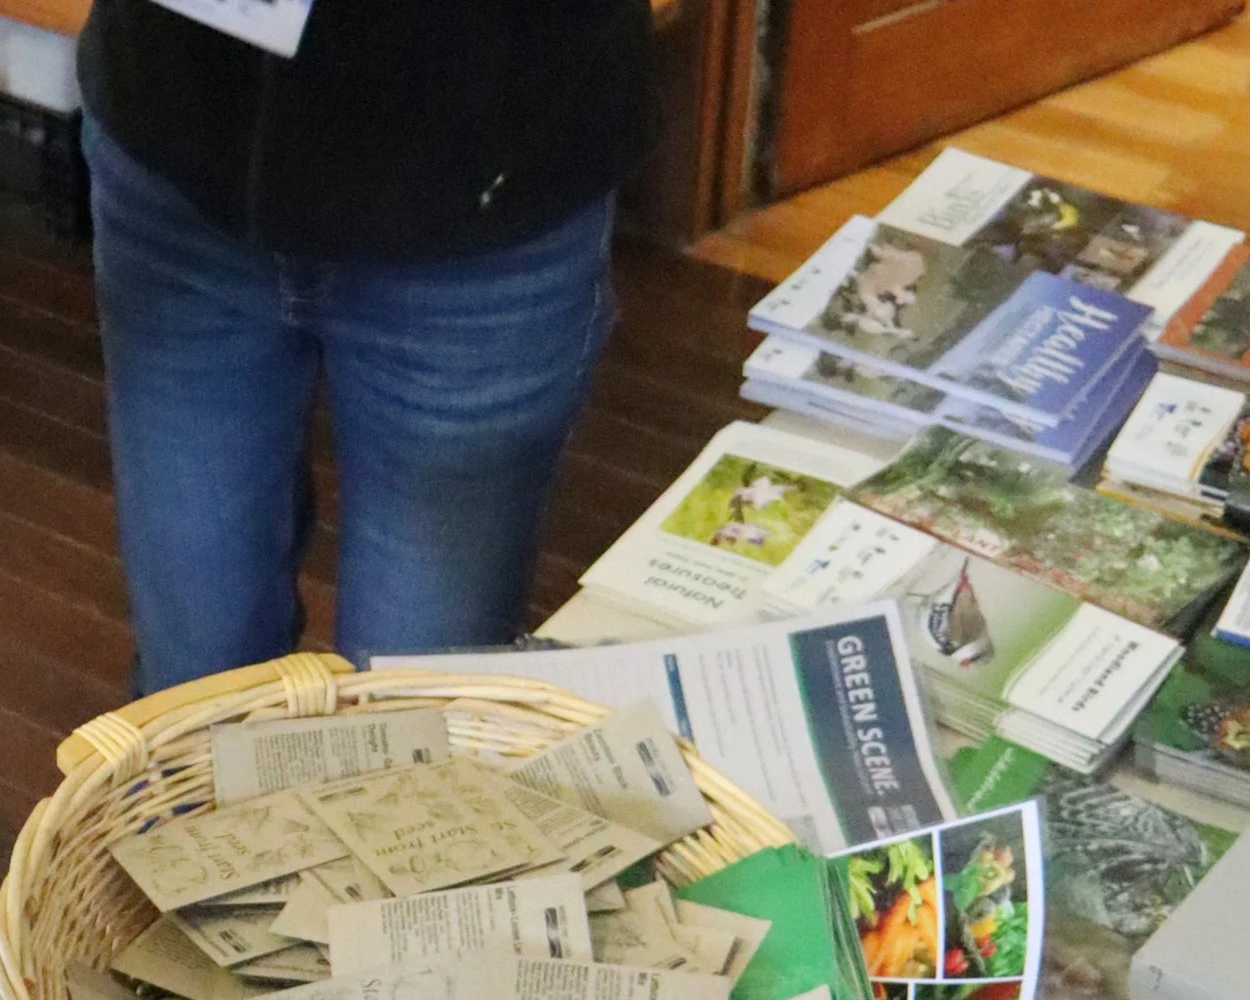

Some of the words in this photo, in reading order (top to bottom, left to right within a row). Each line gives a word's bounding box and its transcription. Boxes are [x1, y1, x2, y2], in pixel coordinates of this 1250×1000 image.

[996, 296, 1119, 394] Healthy
[643, 575, 724, 609] Natural
[648, 558, 747, 600] Treasures
[837, 635, 878, 722] GREEN
